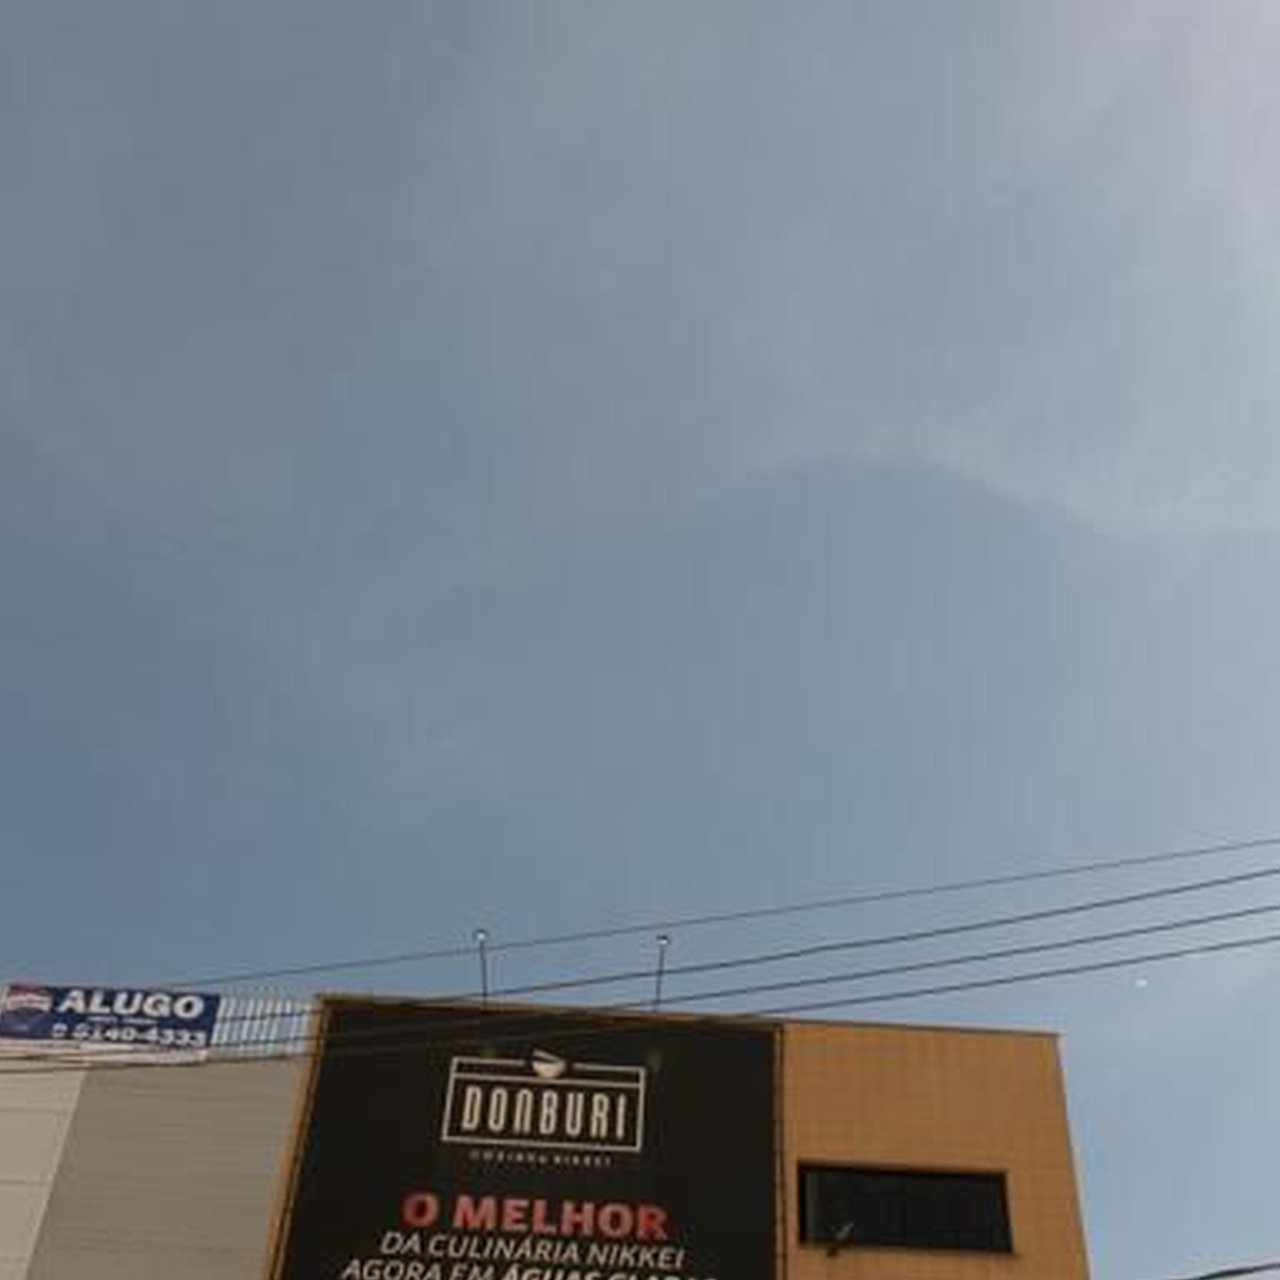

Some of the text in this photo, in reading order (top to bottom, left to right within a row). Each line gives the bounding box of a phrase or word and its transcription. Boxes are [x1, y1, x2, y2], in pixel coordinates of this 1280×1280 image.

[57, 988, 205, 1019] ALUGO
[461, 1085, 626, 1140] DONBURI
[402, 1192, 670, 1240] O MELHOR
[380, 1231, 686, 1271] DA CULINÁRIA NIKKEI
